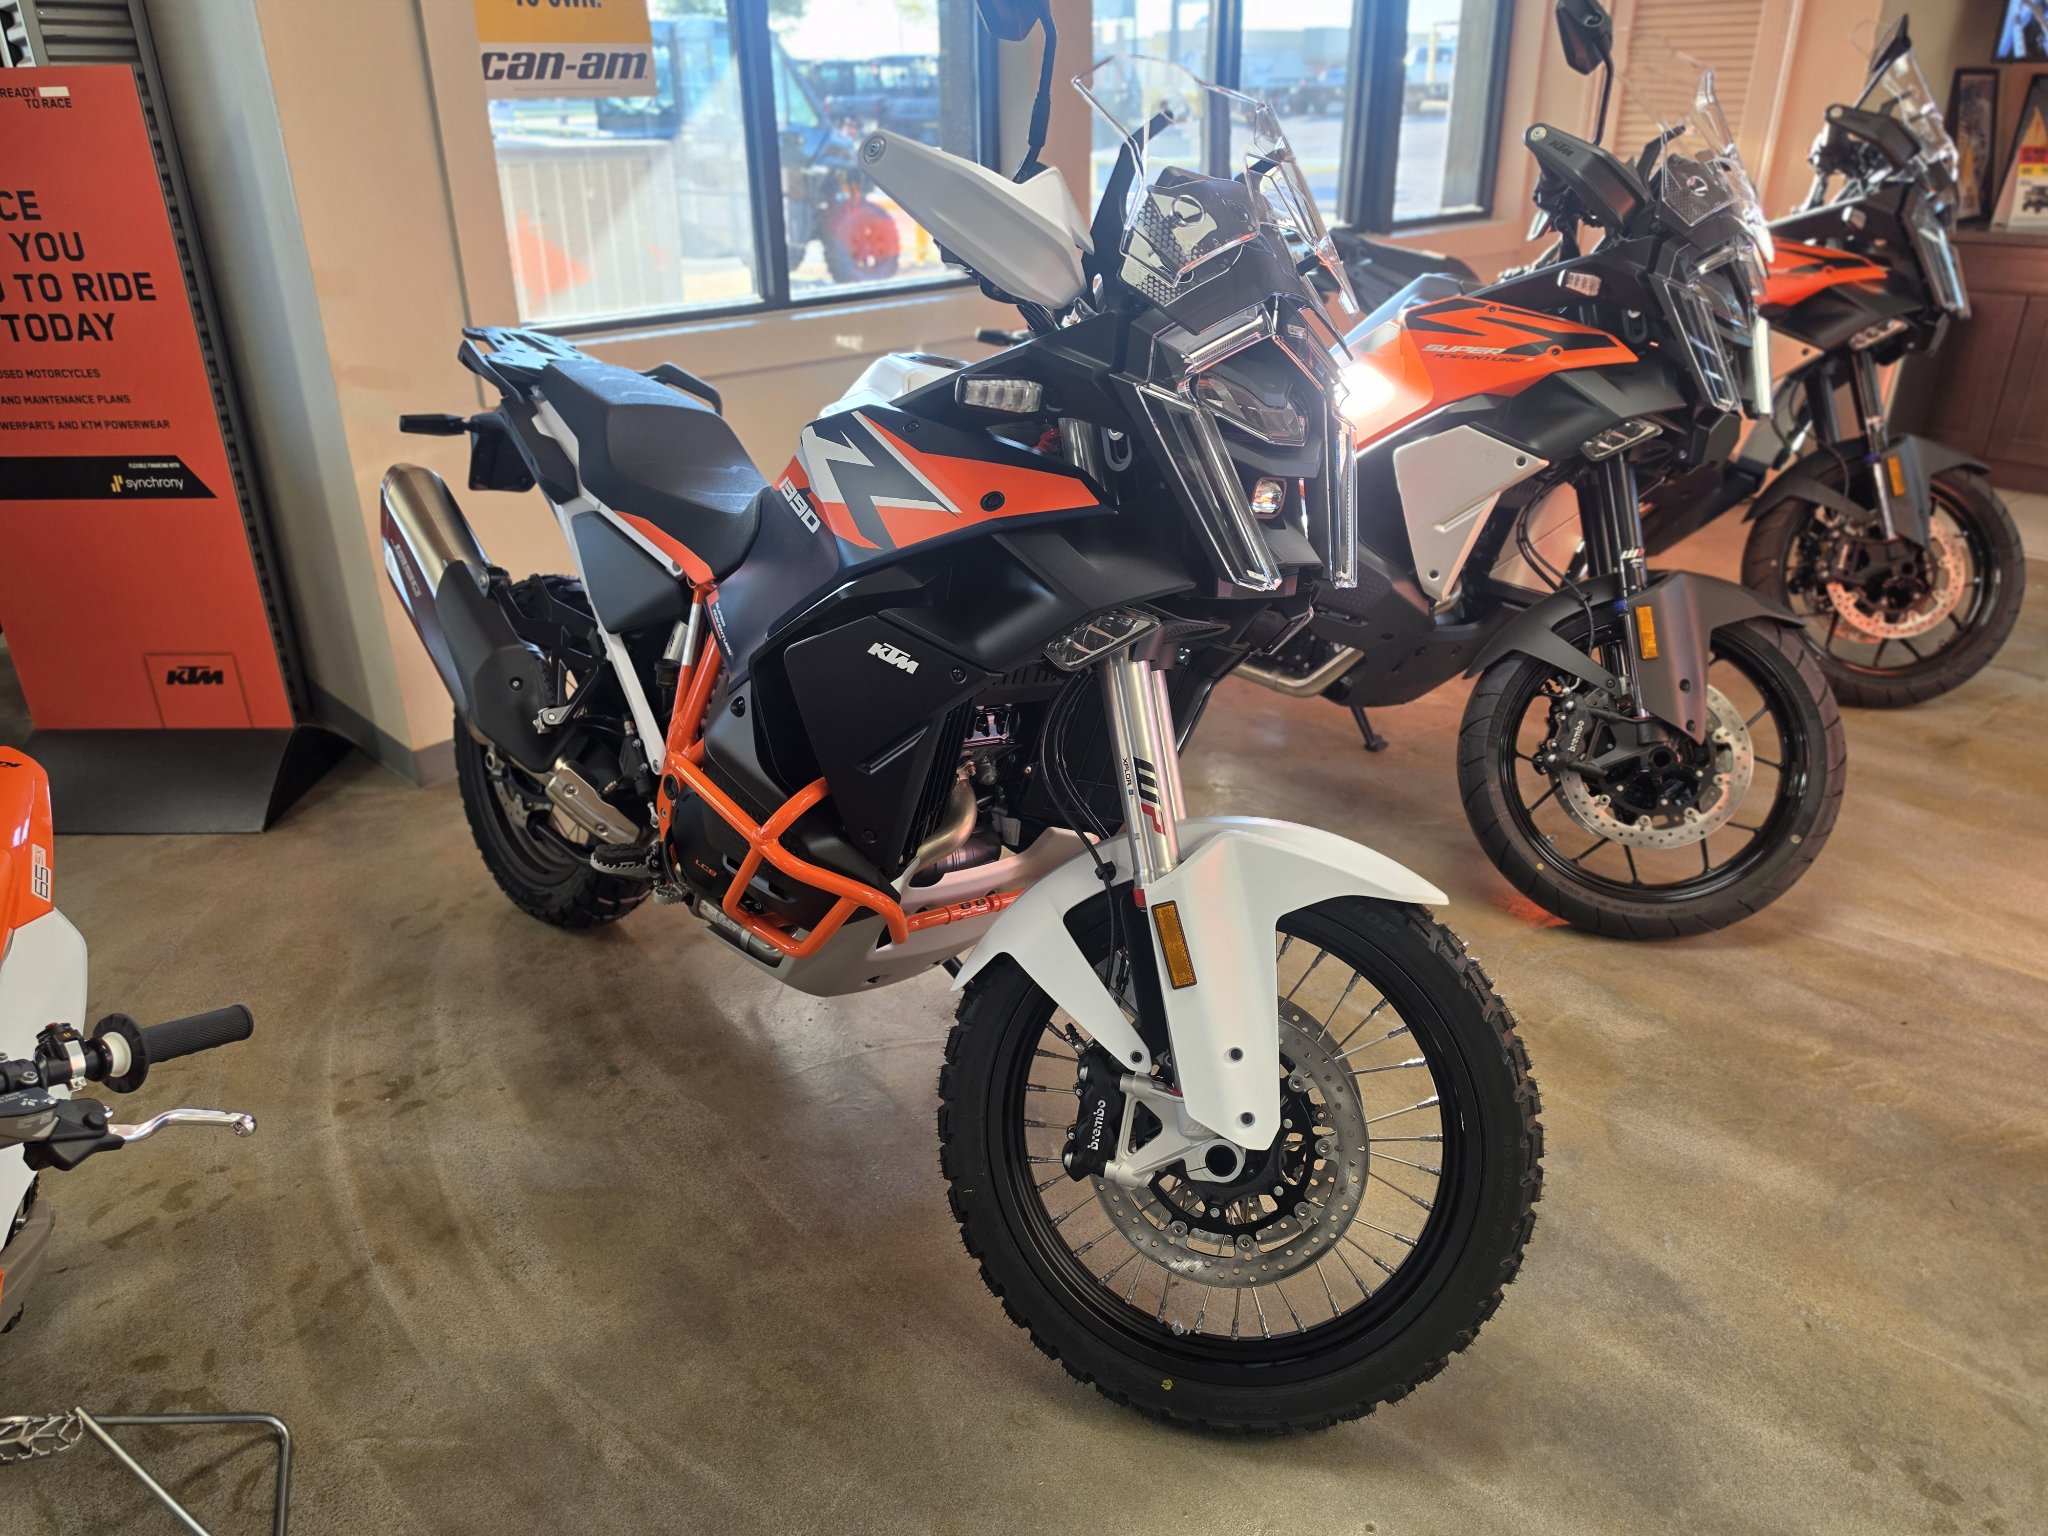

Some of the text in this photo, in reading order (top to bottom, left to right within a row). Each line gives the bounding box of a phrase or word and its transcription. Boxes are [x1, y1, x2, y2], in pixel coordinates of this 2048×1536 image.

[0, 87, 36, 98] READY
[24, 98, 73, 109] TO RACE
[8, 231, 86, 263] YOU
[13, 272, 63, 303] TO
[72, 272, 157, 302] RIDE
[0, 312, 116, 342] TODAY
[1421, 344, 1507, 355] SUPER
[26, 368, 101, 379] MOTORCYCLES
[24, 394, 95, 405] MAINTENANCE
[97, 394, 131, 405] PLANS
[58, 420, 79, 430] AND
[82, 420, 101, 430] KTM
[105, 419, 171, 430] POWERWEAR
[125, 475, 184, 491] synchrony
[867, 642, 919, 675] KTM
[166, 665, 224, 685] KTM
[1568, 720, 1585, 752] brembo
[1087, 1099, 1106, 1151] brembo
